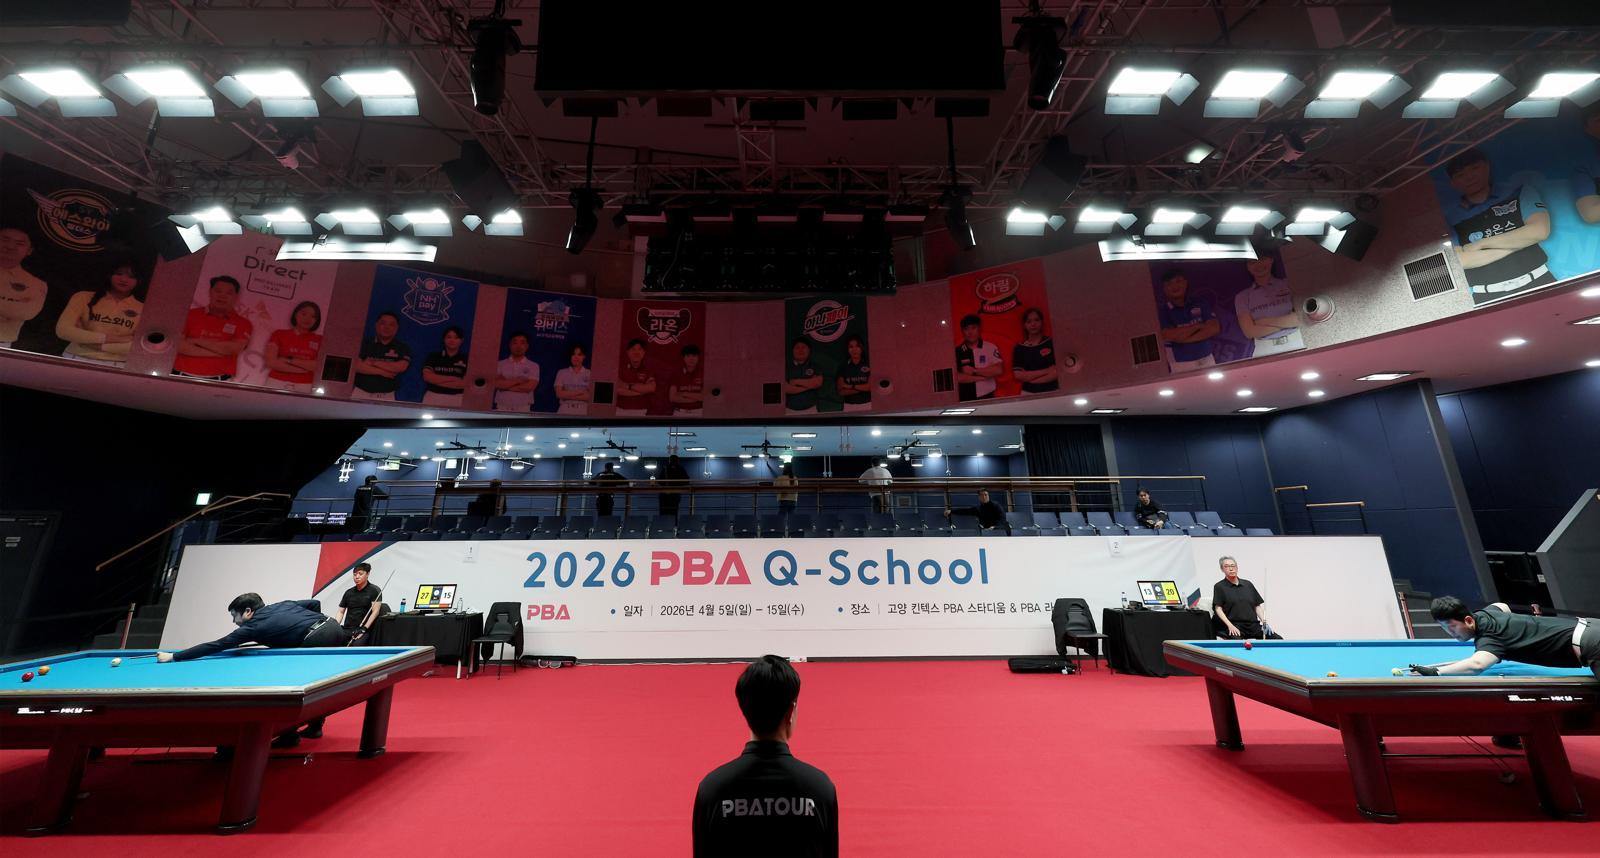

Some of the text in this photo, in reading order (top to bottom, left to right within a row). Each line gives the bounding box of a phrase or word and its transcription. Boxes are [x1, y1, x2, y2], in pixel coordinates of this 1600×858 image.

[244, 255, 308, 281] Direct
[983, 278, 1009, 296] 하림
[649, 318, 679, 333] 라온
[523, 548, 990, 589] 2026 PBA Q-School
[420, 592, 430, 600] 27
[443, 591, 452, 600] 15
[527, 604, 571, 621] PBA
[623, 603, 644, 618] 일자
[660, 604, 695, 618] 2026년
[699, 603, 715, 618] 4월
[719, 602, 751, 619] 5일(일)
[768, 602, 805, 618] 15일(수)
[850, 602, 871, 616] 장소
[887, 602, 908, 617] 고양
[911, 601, 941, 617] 킨텍스
[944, 602, 965, 615] PBA
[968, 601, 1007, 616] 스타디움
[1009, 602, 1018, 614] &
[1020, 601, 1042, 615] PBA
[722, 797, 816, 817] PBATOUR
